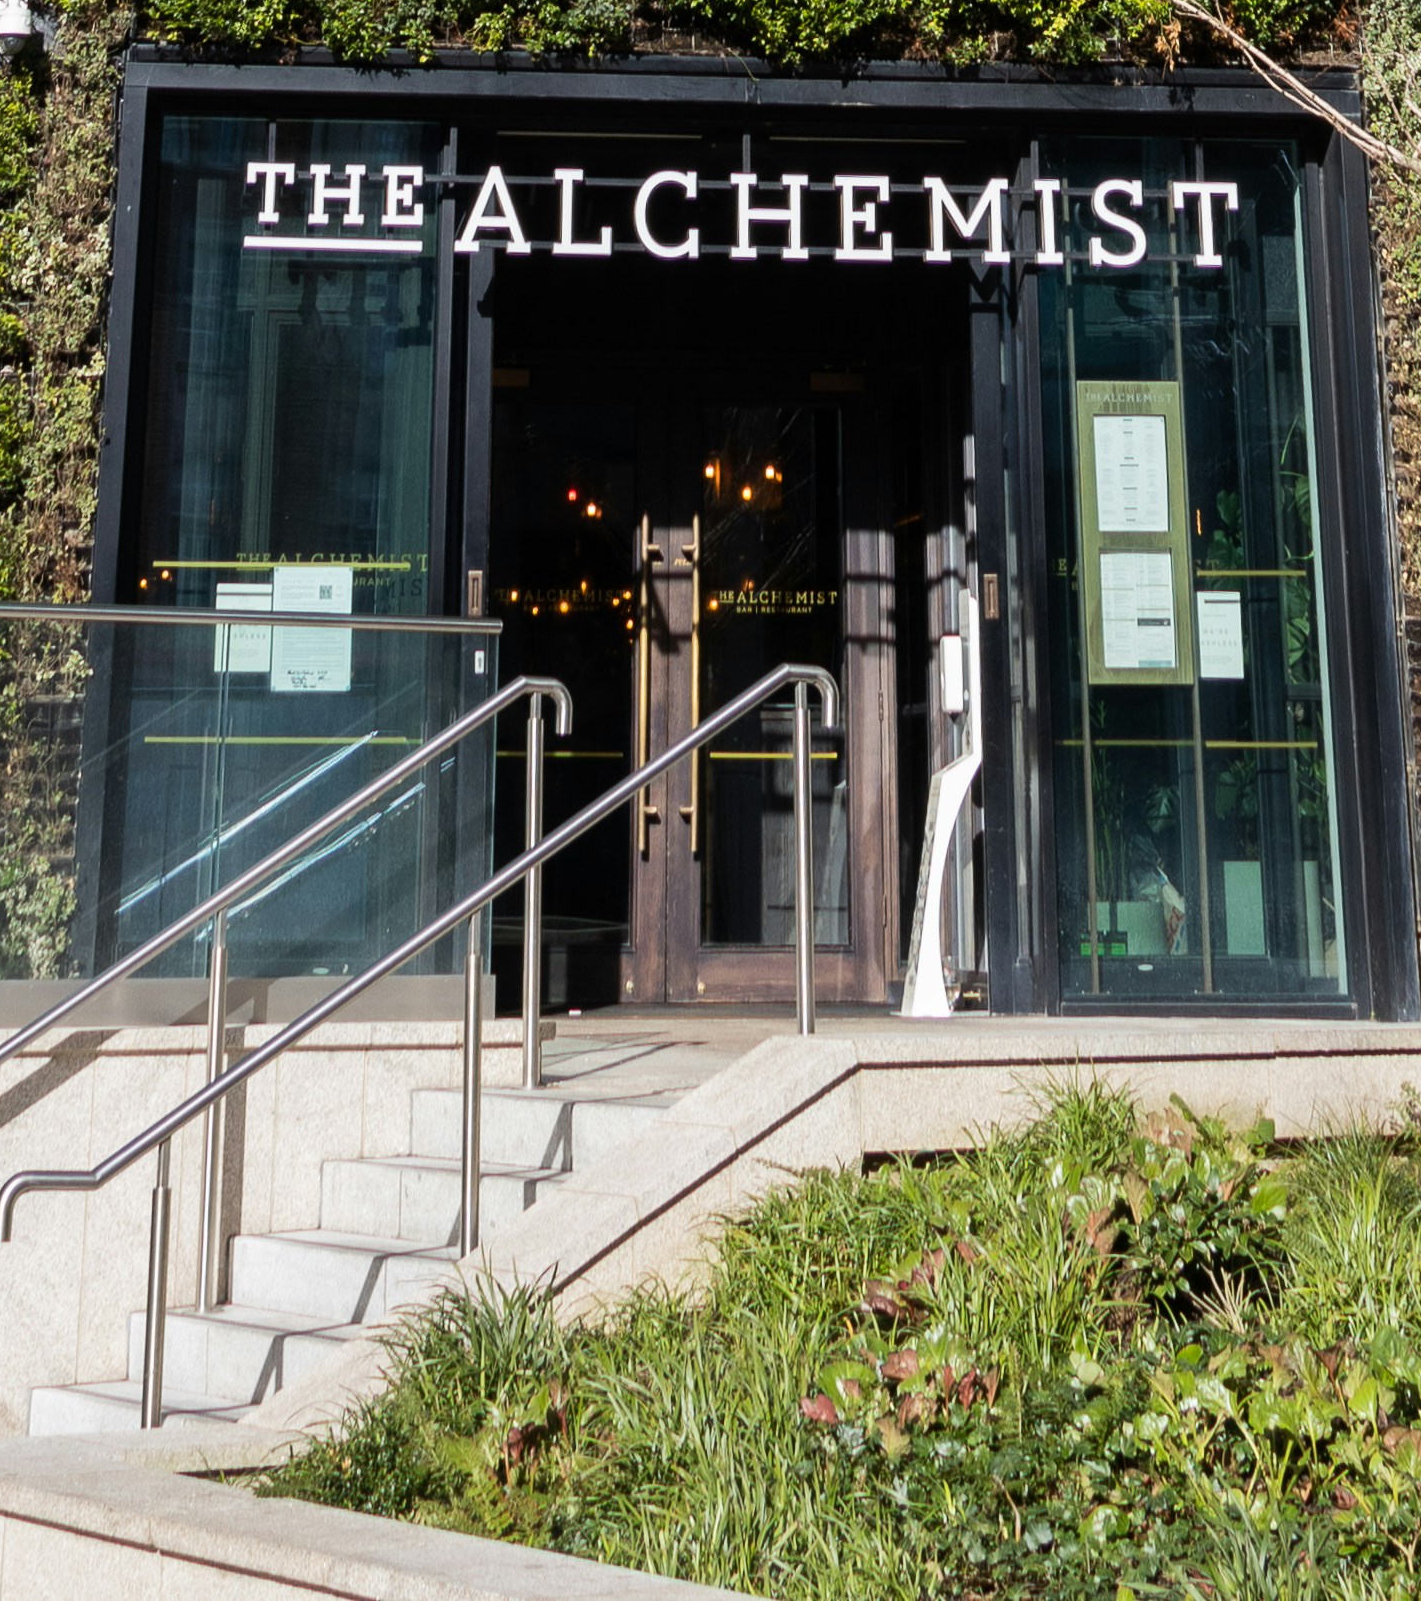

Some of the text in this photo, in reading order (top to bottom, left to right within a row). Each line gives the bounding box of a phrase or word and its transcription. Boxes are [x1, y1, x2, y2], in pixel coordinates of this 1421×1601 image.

[246, 160, 1239, 267] THE ALCHEMIST
[1103, 392, 1173, 403] ALCHEMIST
[736, 590, 838, 605] ALCHEMIST
[736, 606, 753, 614] BAR
